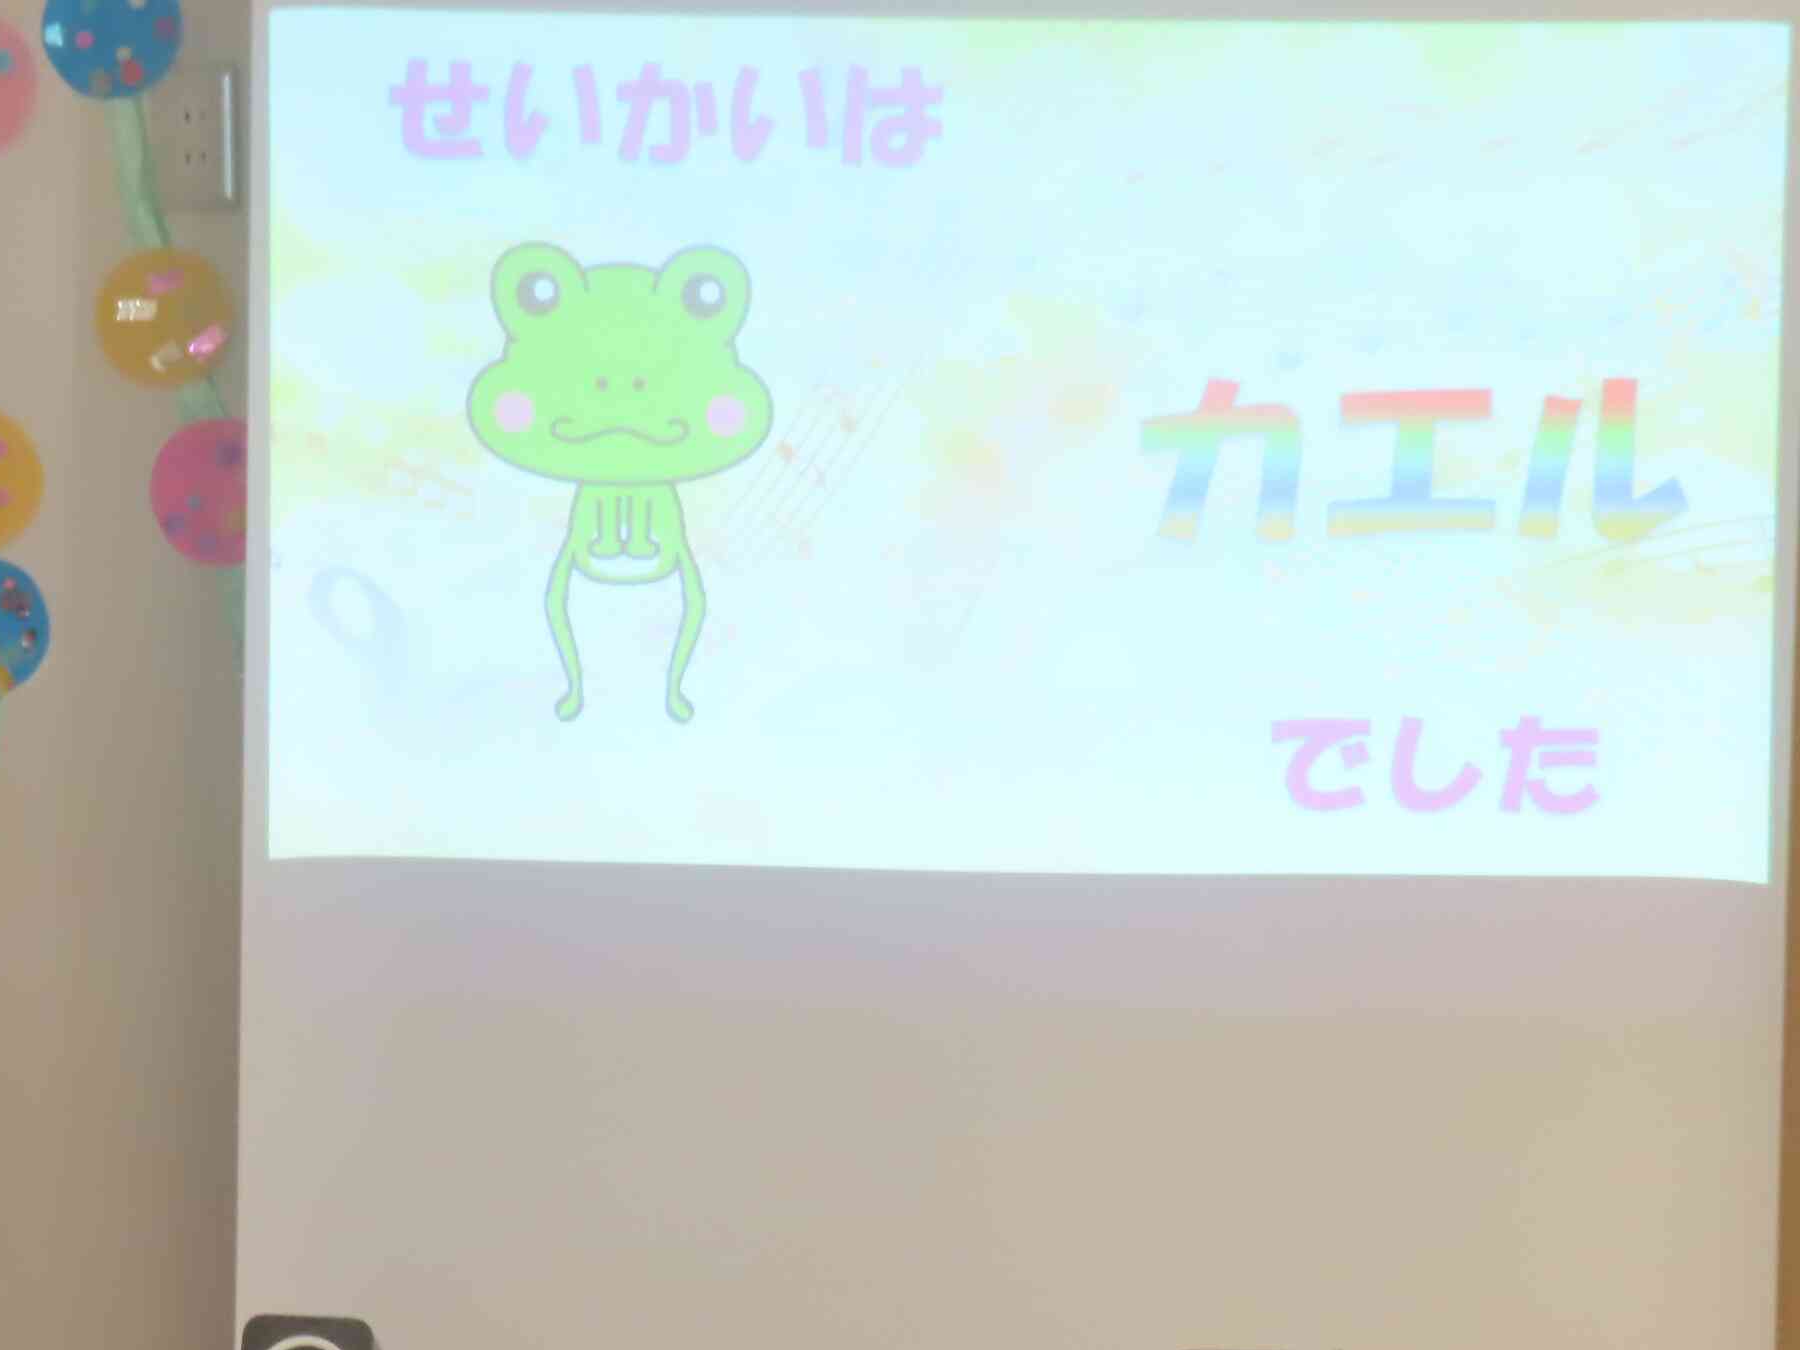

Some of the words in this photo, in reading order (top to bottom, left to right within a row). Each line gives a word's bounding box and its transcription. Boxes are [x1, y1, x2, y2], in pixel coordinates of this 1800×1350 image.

[388, 57, 944, 168] せいかいは
[1140, 377, 1690, 542] カエル
[1271, 715, 1600, 815] でした
